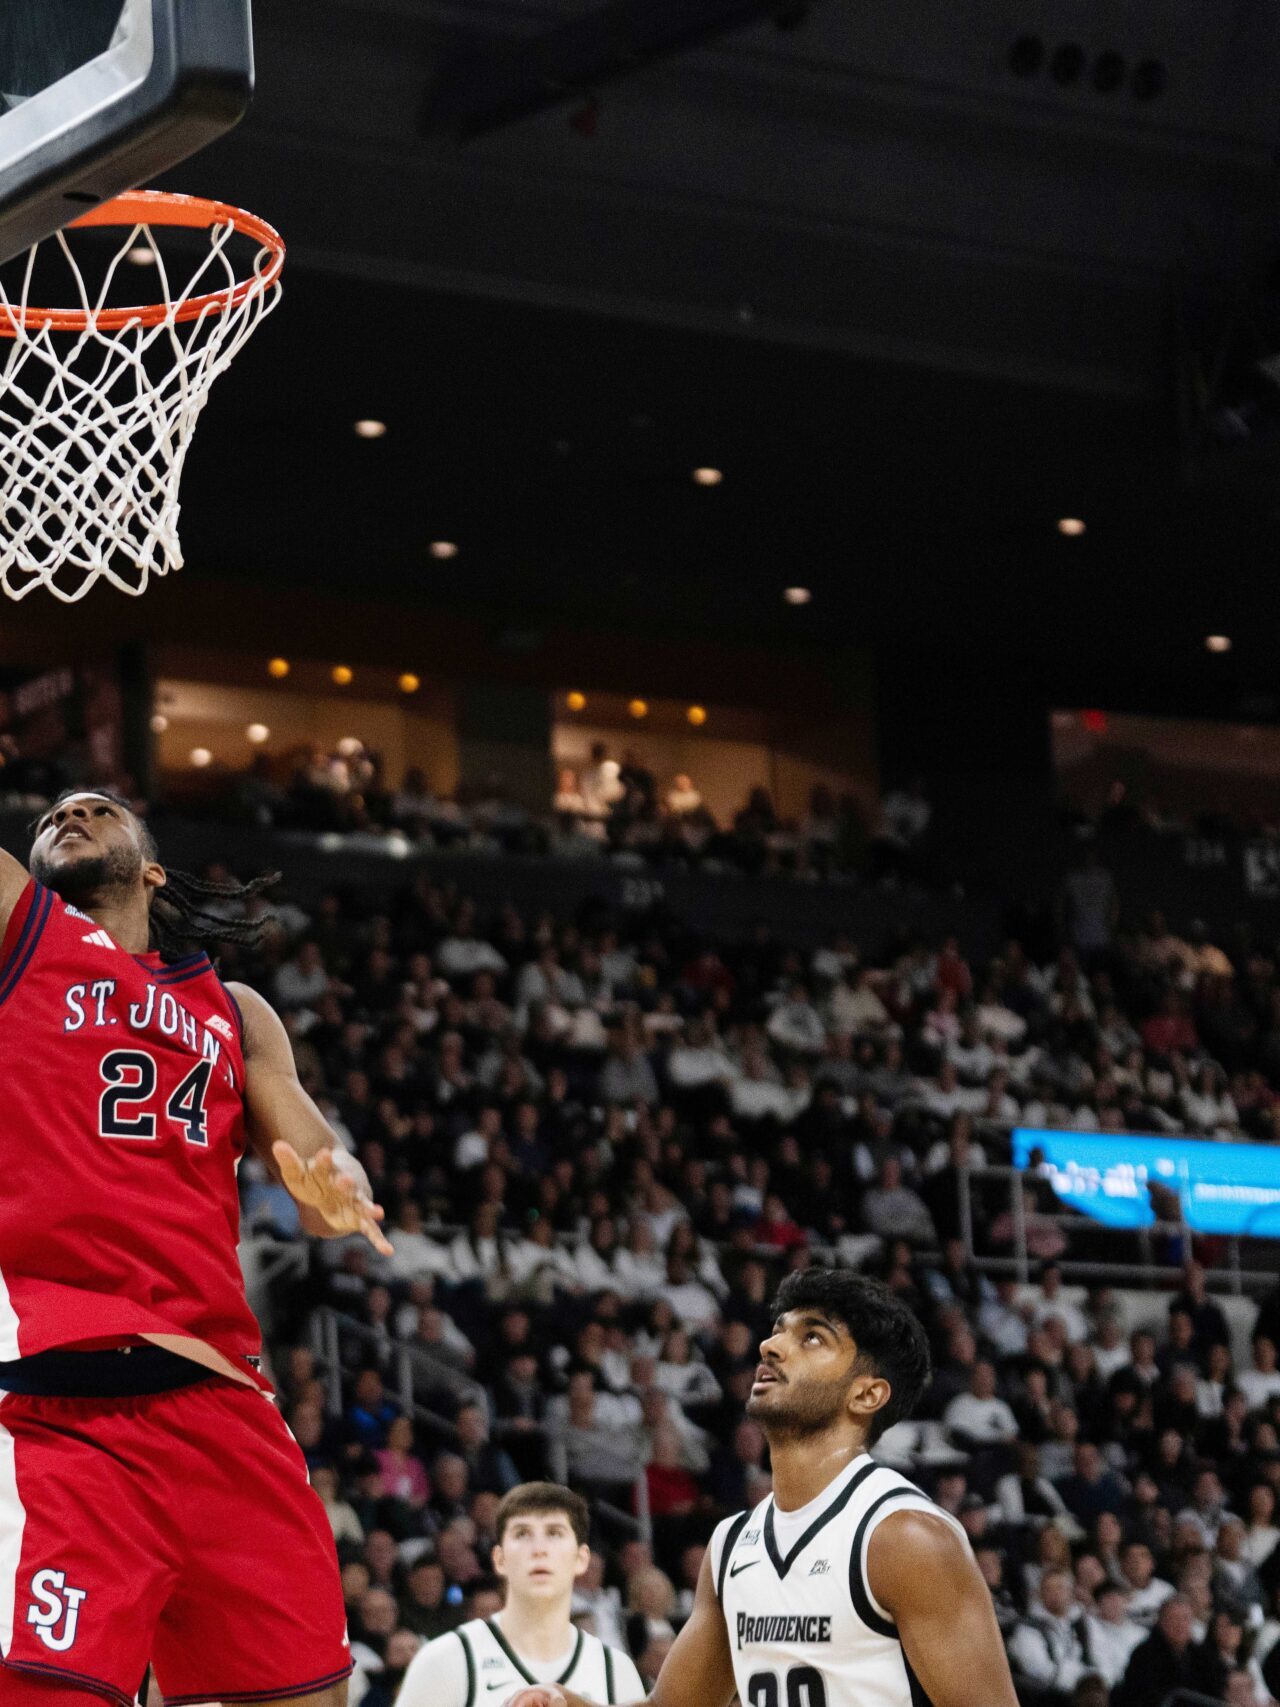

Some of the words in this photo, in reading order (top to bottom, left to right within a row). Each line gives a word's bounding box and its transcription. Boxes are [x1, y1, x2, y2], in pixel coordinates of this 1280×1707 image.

[64, 980, 118, 1033] ST.
[99, 1048, 208, 1147] 24
[736, 1611, 832, 1651] PROVIDENCE
